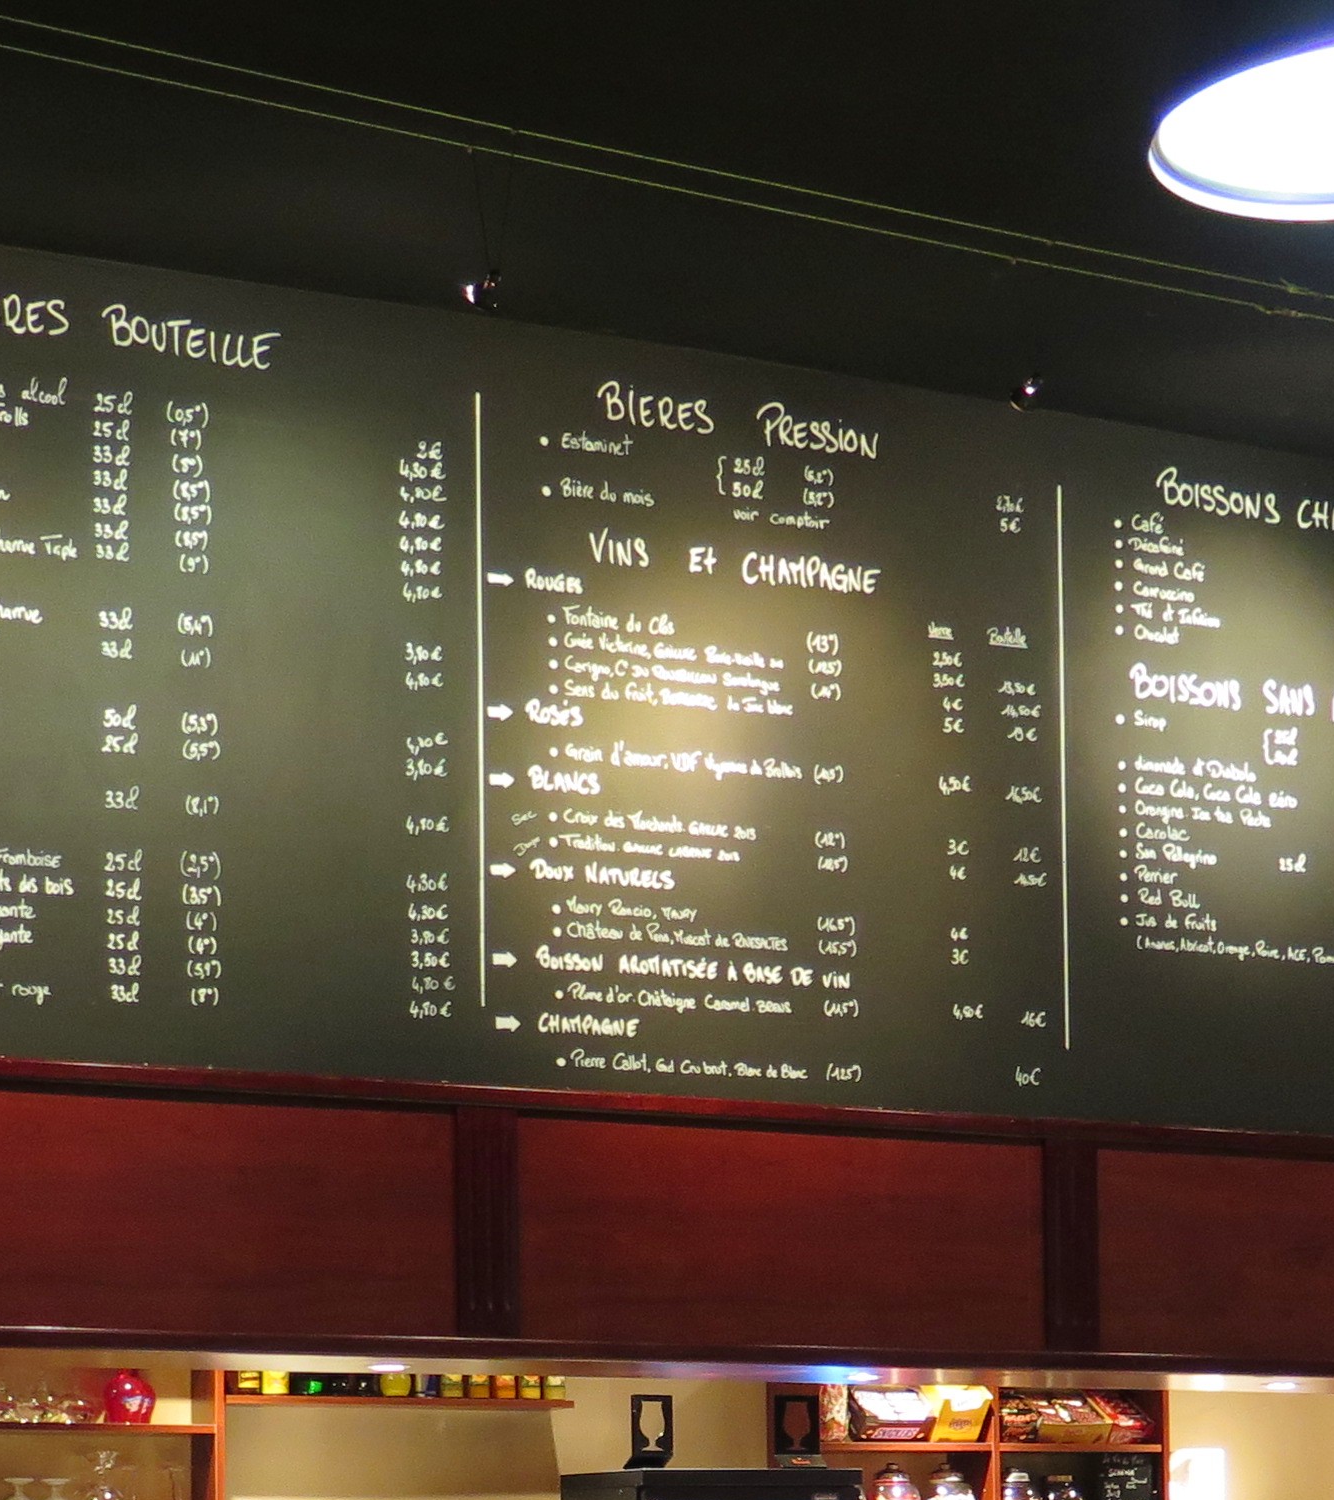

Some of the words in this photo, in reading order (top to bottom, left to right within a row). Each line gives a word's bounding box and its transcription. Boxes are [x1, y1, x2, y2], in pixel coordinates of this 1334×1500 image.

[101, 303, 282, 370] BOUTEILLE
[21, 377, 68, 405] alcool
[598, 380, 715, 435] BIERES
[756, 400, 880, 460] PRESSION
[560, 432, 634, 457] Estaminet
[559, 477, 596, 503] Bière
[600, 483, 618, 503] du
[622, 488, 655, 508] mois
[1156, 465, 1281, 525] BOISSONS
[733, 507, 760, 523] voir
[769, 511, 832, 532] comptoir
[1131, 512, 1164, 534] Café
[588, 527, 650, 569] VINS
[741, 551, 882, 595] CHAMPAGNE
[1174, 561, 1205, 582] Café
[525, 567, 584, 595] ROUGES
[561, 604, 619, 631] Fontaine
[625, 613, 642, 633] du
[601, 682, 620, 700] du
[1129, 662, 1242, 712] BOISSONS
[1262, 678, 1316, 717] SANS
[525, 698, 584, 727] ROSÉS
[1134, 709, 1167, 732] Sirop
[943, 717, 965, 734] 5€
[564, 743, 603, 763] Grain
[527, 764, 602, 795] BLANCS
[1135, 776, 1165, 796] Coca
[563, 808, 599, 826] Croix
[604, 809, 626, 829] des
[1135, 822, 1191, 842] Cacolac
[947, 838, 969, 856] 3€
[44, 876, 74, 896] bois
[529, 857, 575, 882] DOUX
[584, 860, 676, 891] NATURELS
[1133, 864, 1178, 885] Perrier
[1137, 887, 1163, 906] Red
[1168, 889, 1201, 910] Bull
[567, 920, 624, 940] Château
[629, 923, 643, 941] de
[1135, 913, 1157, 928] Jus
[1164, 914, 1179, 930] de
[1184, 913, 1217, 933] Fruits
[535, 944, 604, 973] BOISSON
[619, 953, 718, 980] AROMATISÉE
[741, 961, 784, 985] BASE
[790, 965, 814, 988] DE
[12, 983, 52, 1005] rouge
[537, 1011, 641, 1039] CHAMPAGNE
[570, 1048, 607, 1069] Pierre
[766, 1064, 778, 1079] de
